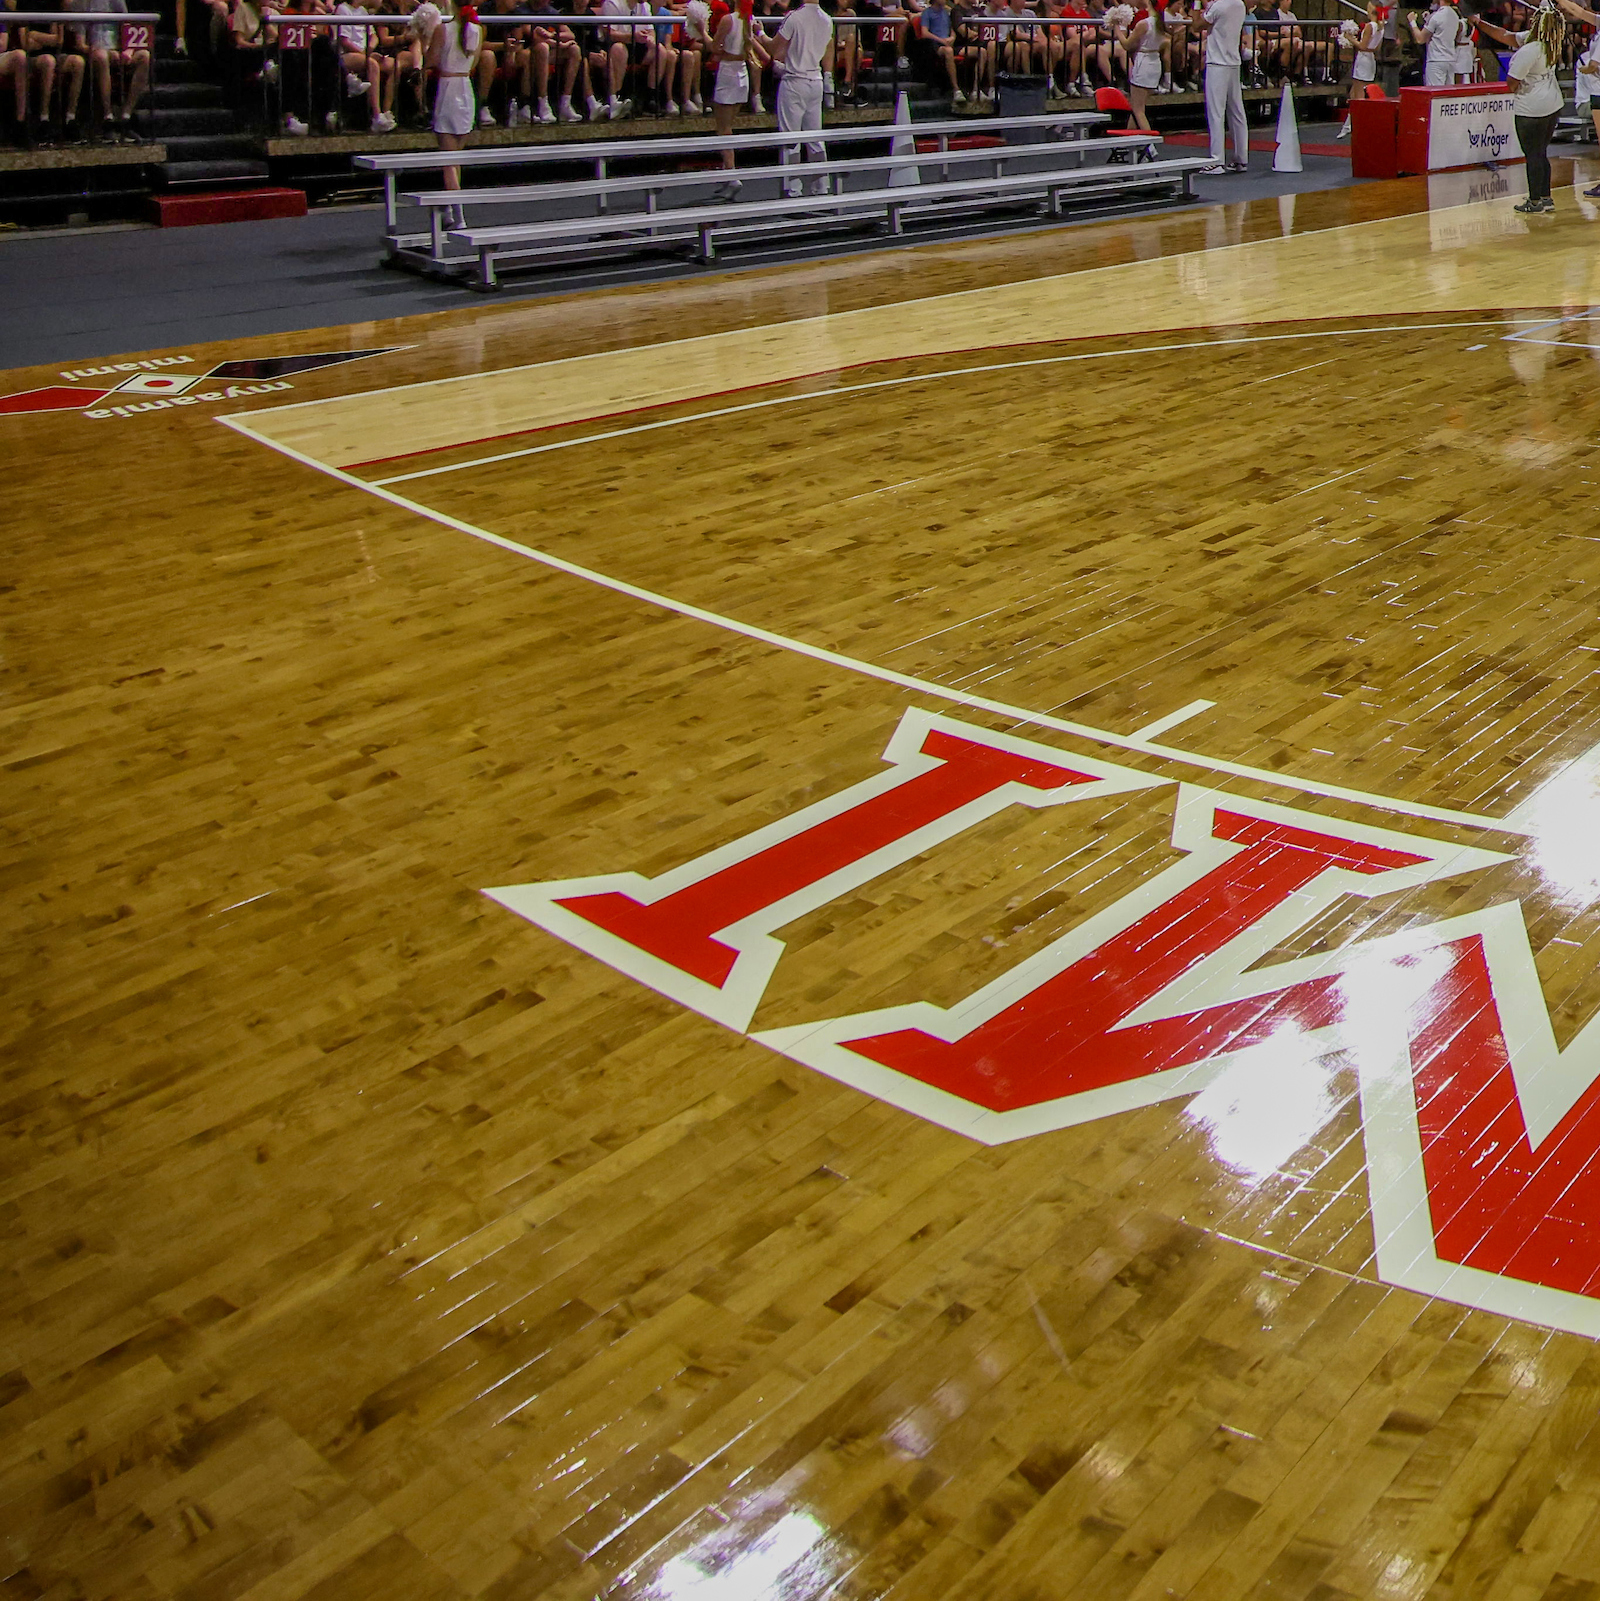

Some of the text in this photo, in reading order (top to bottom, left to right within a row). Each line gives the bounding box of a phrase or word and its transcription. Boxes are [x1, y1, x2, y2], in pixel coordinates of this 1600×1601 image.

[127, 27, 149, 48] 22
[287, 27, 305, 48] 21
[882, 27, 896, 42] 21
[983, 25, 996, 40] 20
[1440, 99, 1515, 117] FREE PICKUP FOR TH
[1481, 124, 1509, 157] Kroger
[59, 355, 195, 382] miami
[83, 381, 295, 420] myaamia
